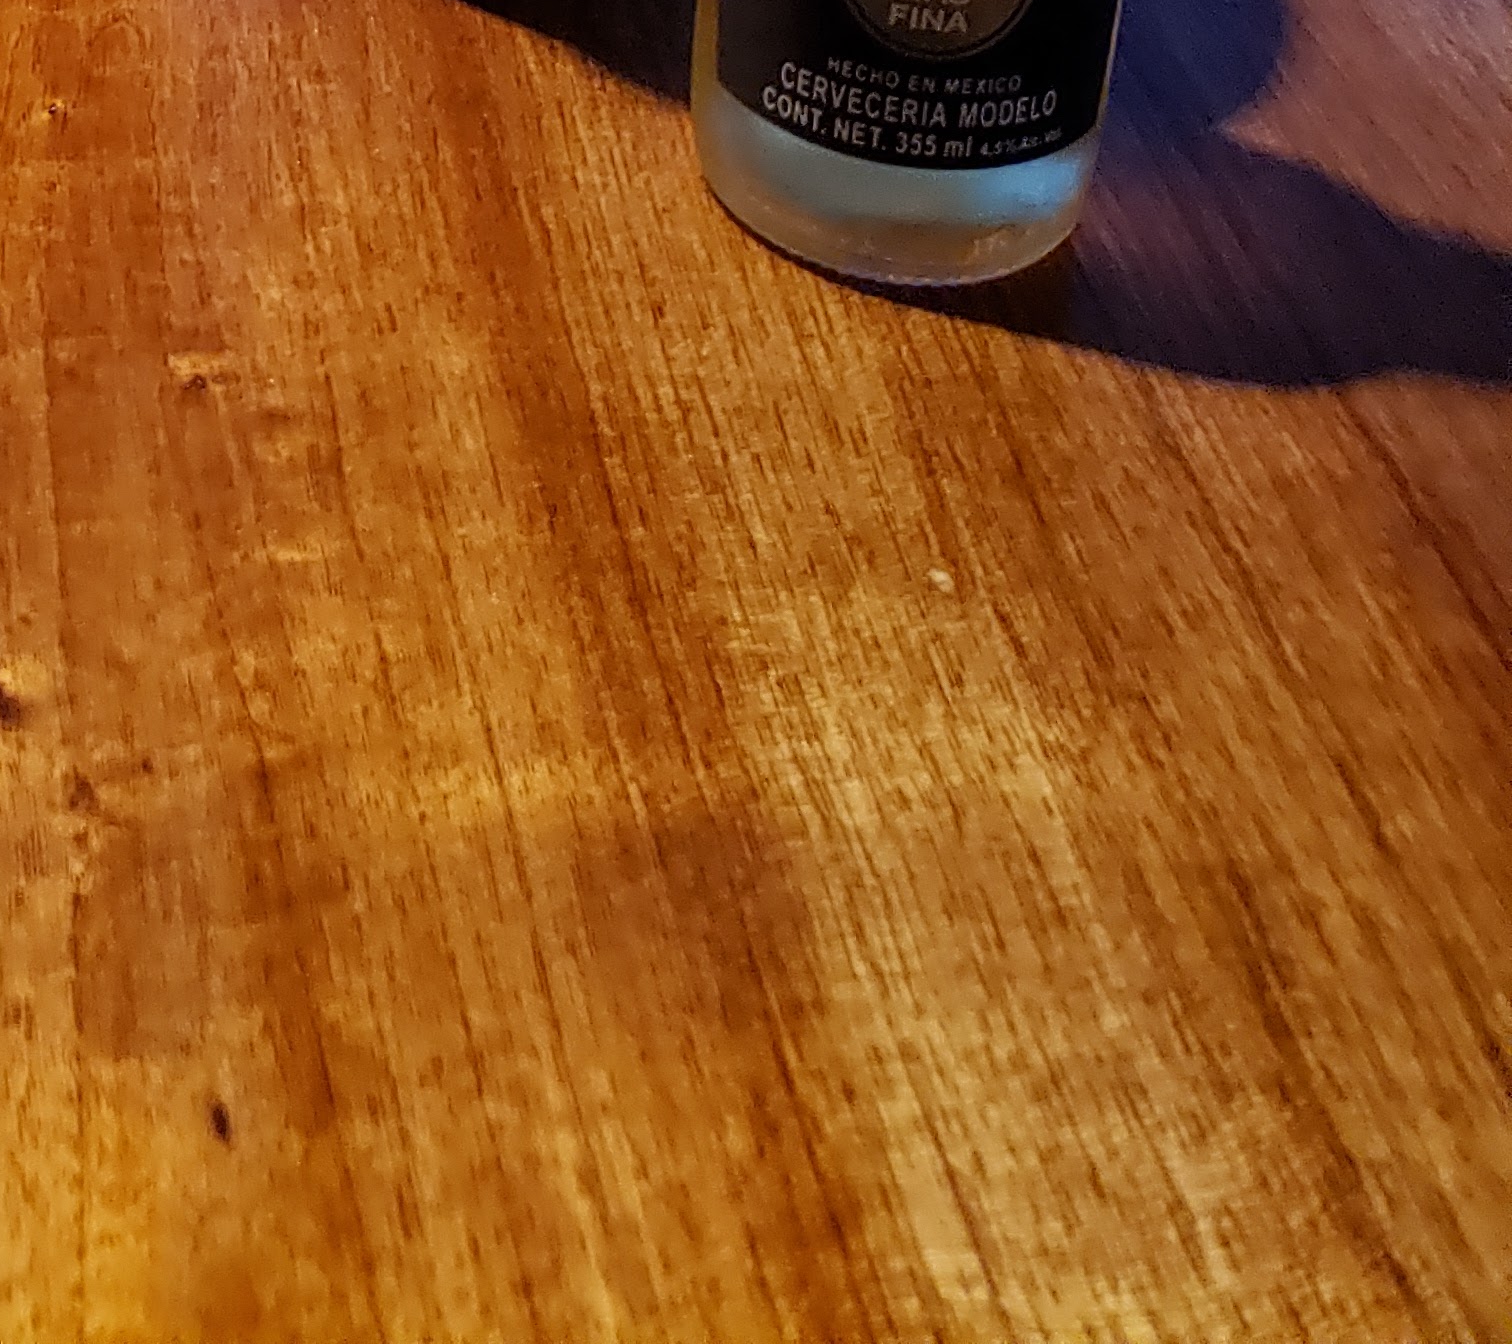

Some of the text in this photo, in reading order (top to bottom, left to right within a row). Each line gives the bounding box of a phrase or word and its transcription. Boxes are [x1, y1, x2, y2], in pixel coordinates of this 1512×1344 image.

[889, 2, 969, 34] FINA
[780, 61, 1058, 129] CERVECERIA MODELO
[828, 56, 1023, 95] HECHO EN MEXICO
[762, 85, 828, 136] CONT.
[834, 118, 887, 151] NET.
[895, 131, 938, 157] 355
[942, 135, 974, 158] ml
